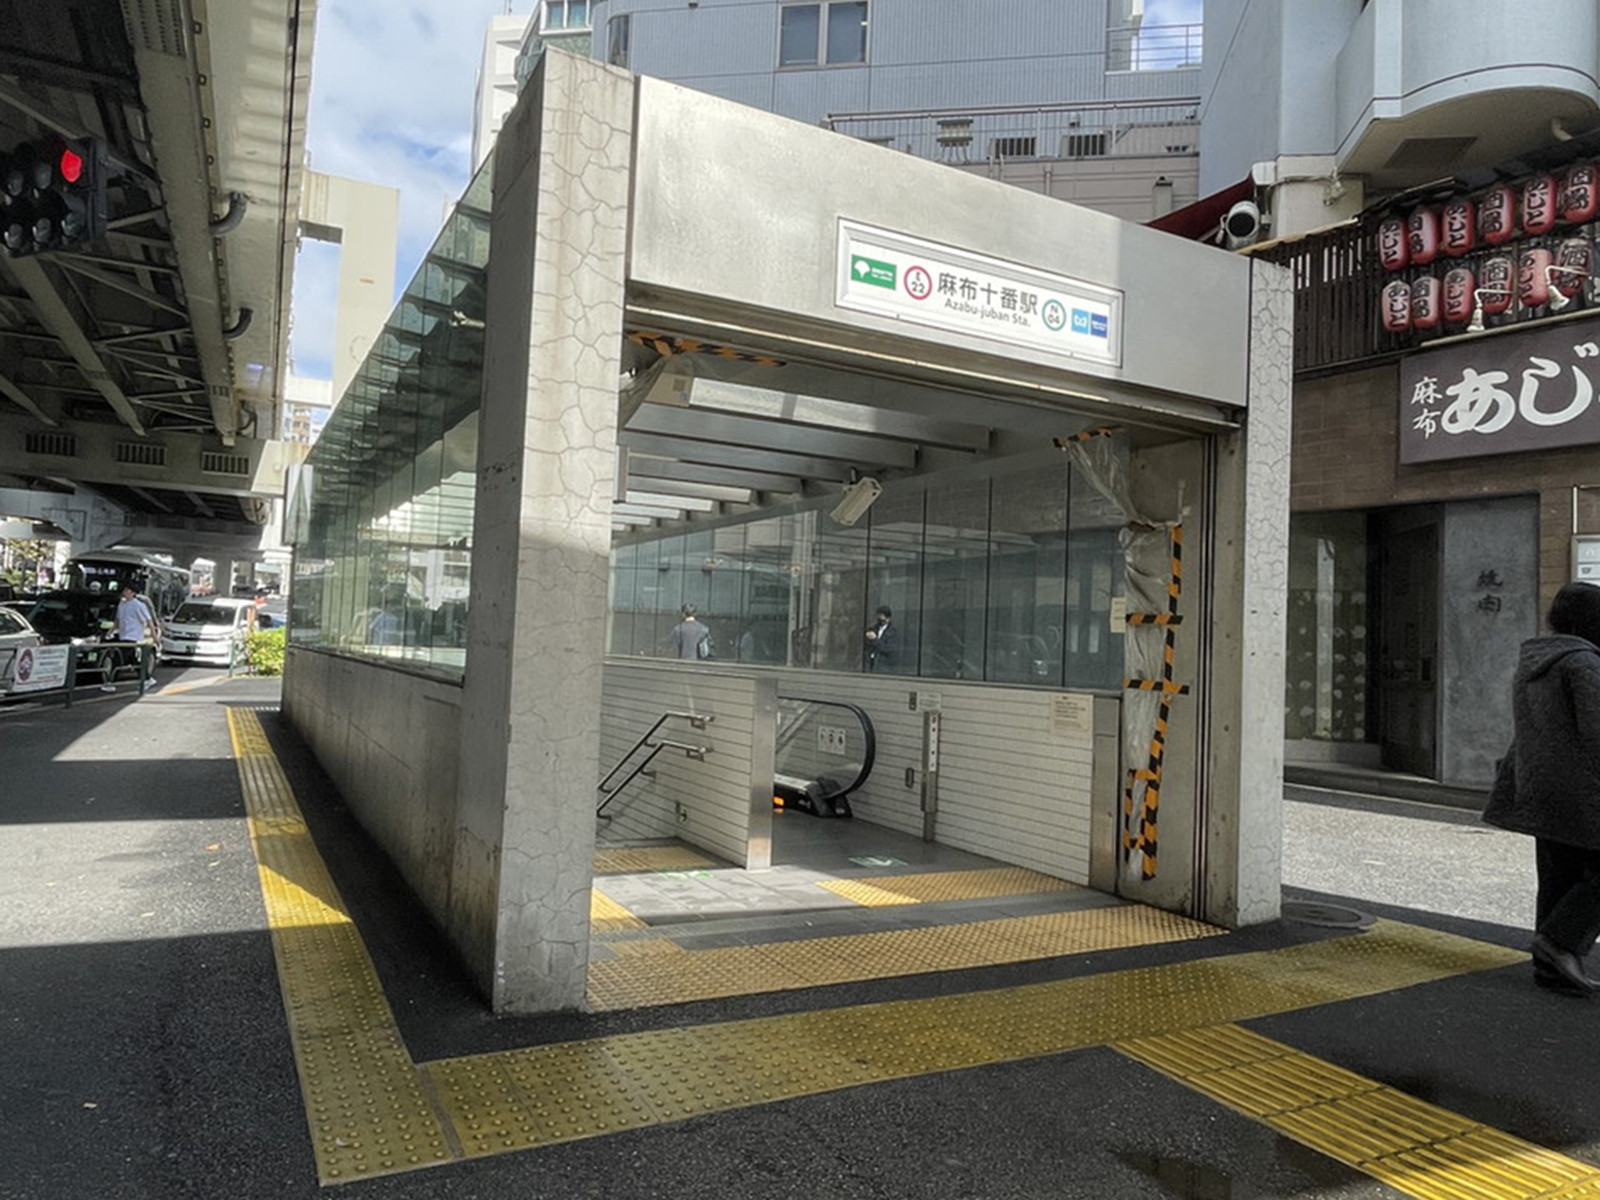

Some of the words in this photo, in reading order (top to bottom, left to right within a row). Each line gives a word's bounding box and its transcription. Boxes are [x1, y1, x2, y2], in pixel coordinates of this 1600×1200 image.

[911, 281, 925, 294] 22
[937, 272, 1038, 315] 麻布十番駅
[944, 297, 1009, 325] Azabu-juban
[1010, 311, 1031, 327] Sta.
[1047, 314, 1060, 325] 04
[1441, 341, 1600, 434] あじ
[1410, 376, 1443, 439] 麻布
